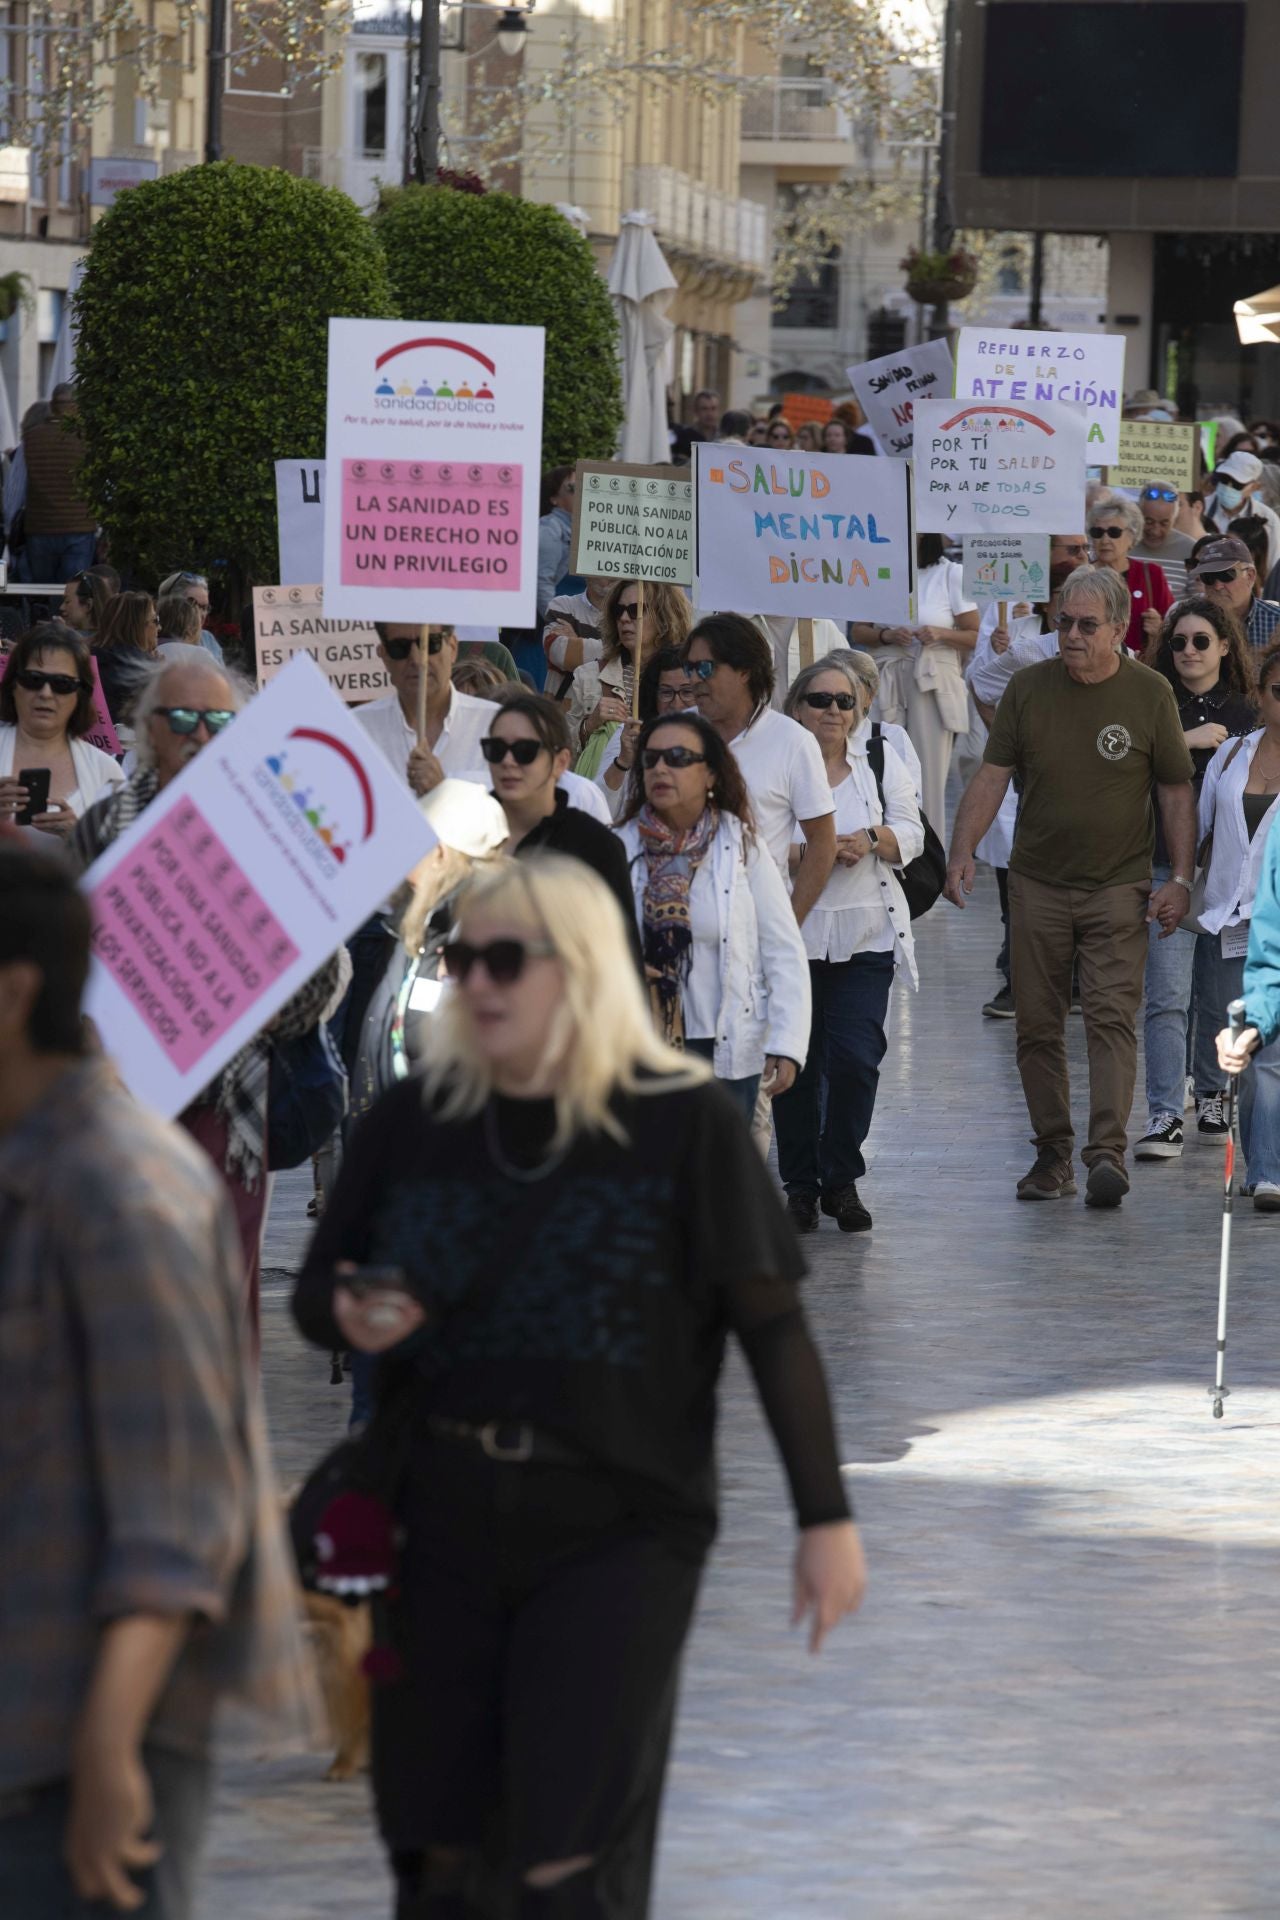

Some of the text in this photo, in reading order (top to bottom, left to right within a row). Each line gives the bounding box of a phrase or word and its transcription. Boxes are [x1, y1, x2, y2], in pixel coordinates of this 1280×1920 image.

[978, 340, 1086, 361] REFUERZO
[994, 363, 1058, 379] DE LA
[932, 437, 963, 453] POR
[1119, 439, 1190, 452] OR UNA SANIDAD
[930, 456, 1056, 471] POR TU SALUD
[1119, 450, 1151, 462] ÚBLICA.
[1153, 454, 1168, 463] NO
[1175, 456, 1187, 464] LA
[728, 460, 831, 499] SALUD
[1120, 477, 1137, 486] LOS
[1177, 469, 1188, 477] DE
[929, 480, 1047, 494] POR LA DE TODAS
[356, 495, 510, 517] LA SANIDAD ES
[588, 501, 692, 522] POR UNA SANIDAD
[971, 502, 1030, 517] TODOS
[346, 524, 519, 546] UN DERECHO NO
[590, 519, 689, 541] PÚBLICA. NO A LA
[754, 510, 892, 544] MENTAL
[586, 539, 689, 561] PRIVATIZACIÓN DE
[356, 554, 508, 574] UN PRIVILEGIO
[597, 560, 677, 578] LOS SERVICIOS
[259, 620, 285, 637] LA
[261, 649, 283, 666] ES
[326, 643, 376, 662] GAST
[175, 873, 207, 914] UNA
[203, 911, 262, 991] SANIDAD
[184, 938, 210, 972] NO
[212, 982, 236, 1012] LA
[116, 957, 182, 1046] SERVICIOS
[191, 1008, 216, 1036] DE
